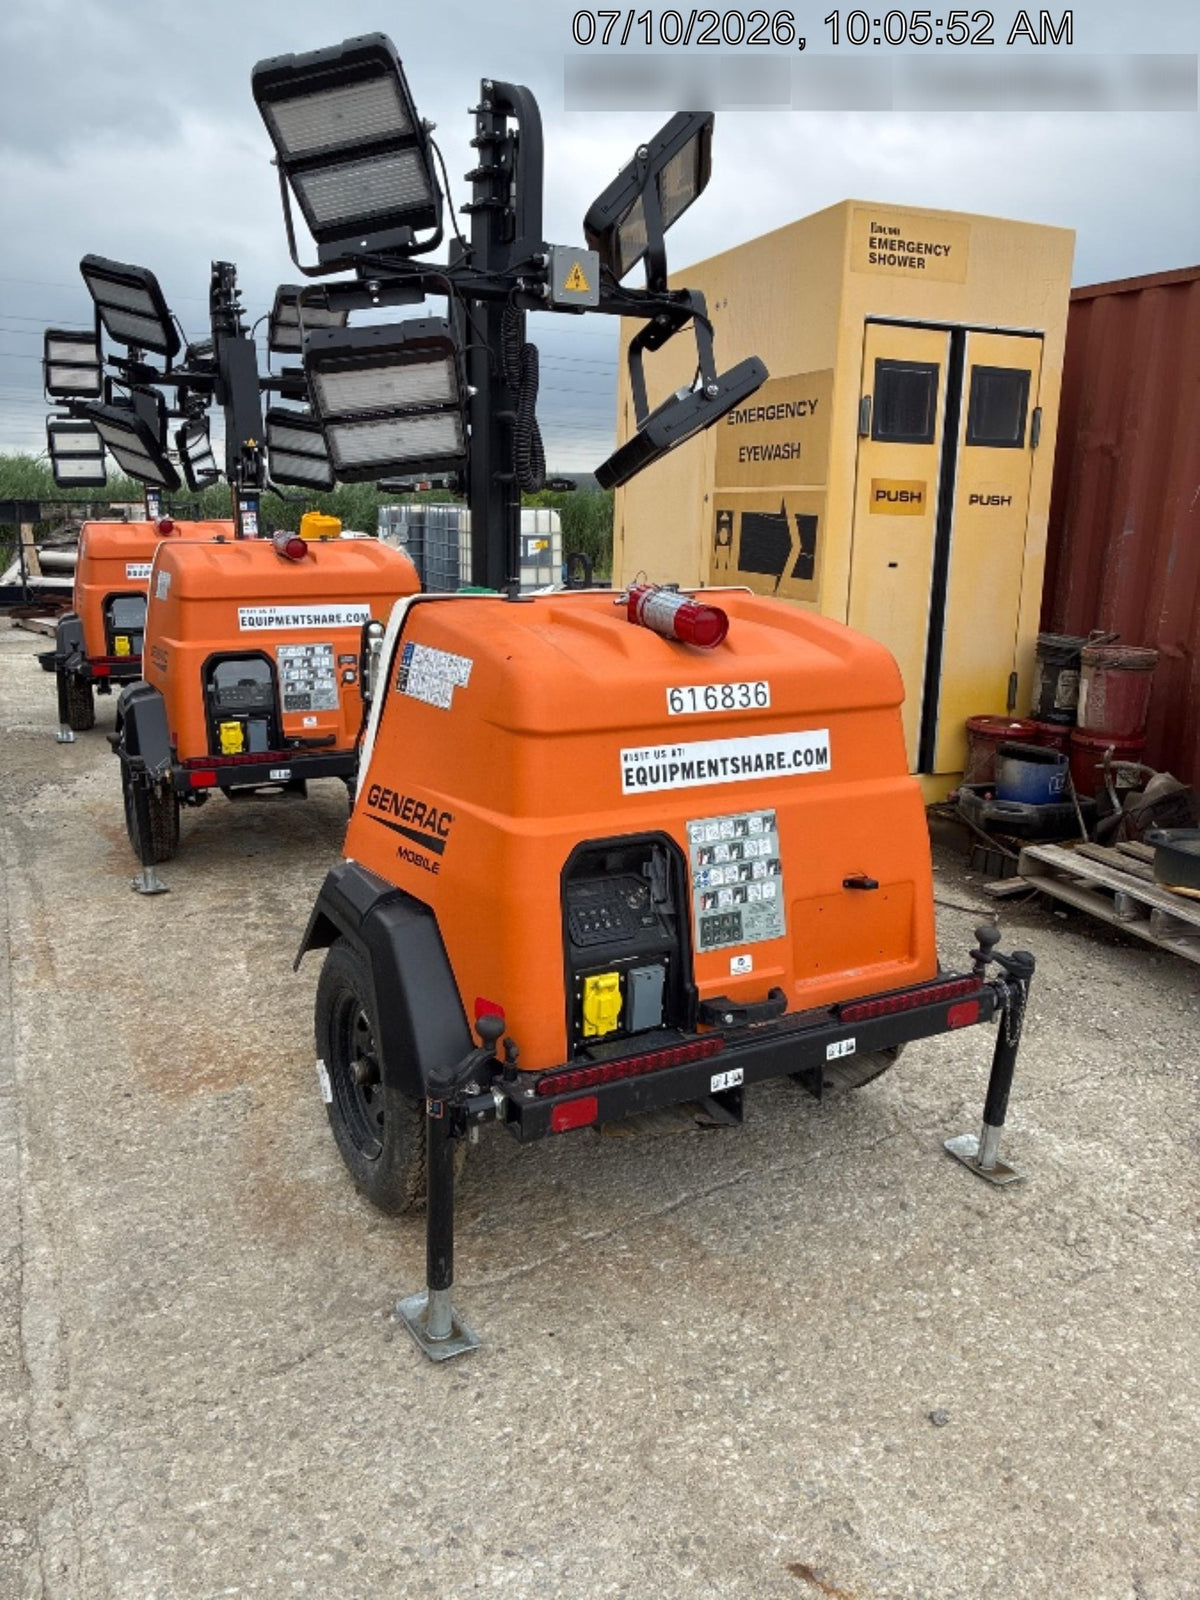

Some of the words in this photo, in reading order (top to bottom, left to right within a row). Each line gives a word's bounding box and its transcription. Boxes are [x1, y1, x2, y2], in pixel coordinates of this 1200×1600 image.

[869, 237, 951, 256] EMERGENCY
[869, 252, 926, 269] SHOWER
[727, 398, 818, 426] EMERGENCY
[739, 442, 801, 463] EYEWASH
[875, 489, 922, 504] PUSH
[969, 494, 1012, 506] PUSH
[241, 612, 369, 628] EQUIPMENTSHARE.COM
[669, 682, 768, 713] 616836
[654, 749, 667, 760] US
[624, 746, 828, 787] EQUIPMENTSHARE.COM
[367, 783, 452, 837] GENERAC
[396, 846, 440, 875] MOBILE
